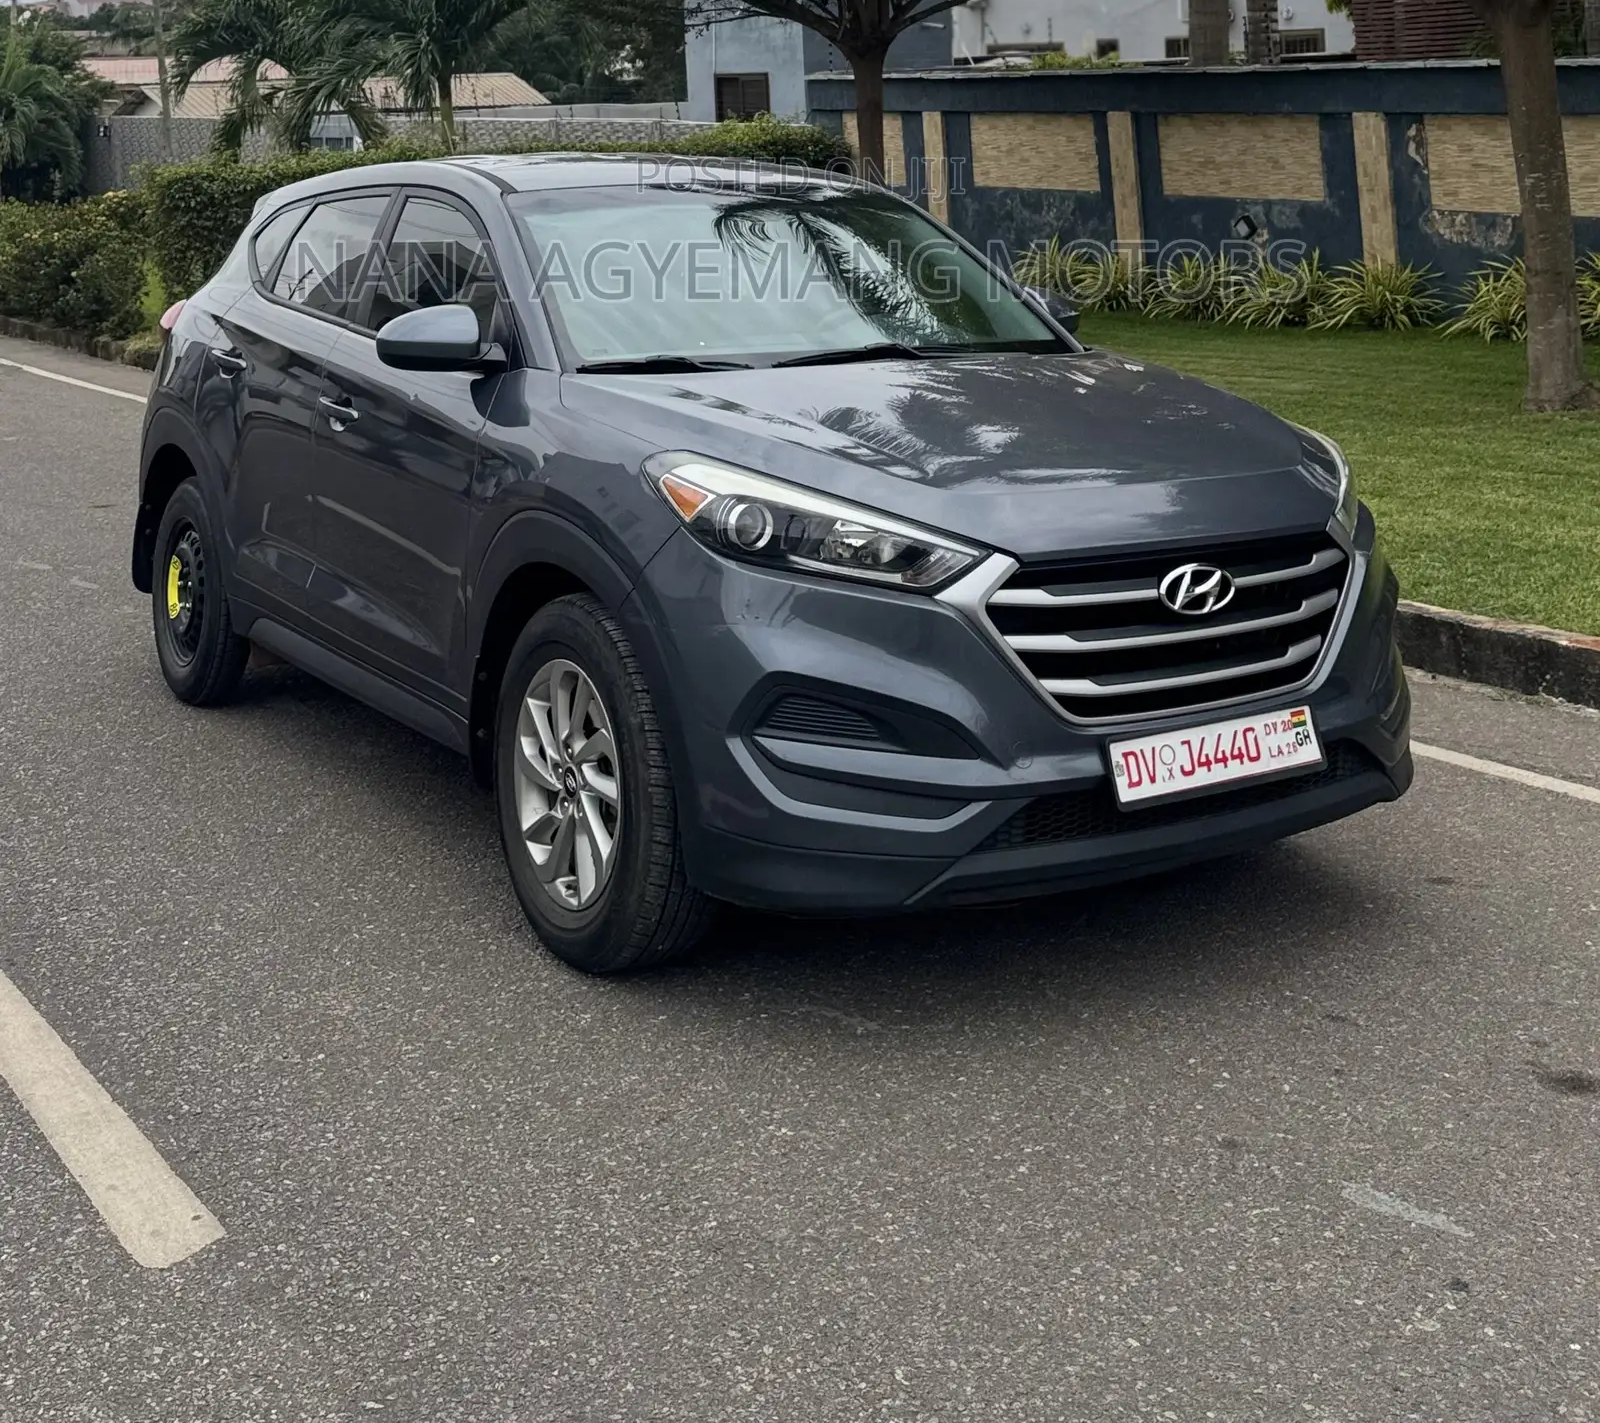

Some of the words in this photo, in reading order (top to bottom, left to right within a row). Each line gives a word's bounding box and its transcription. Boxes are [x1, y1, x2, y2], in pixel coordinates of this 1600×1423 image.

[1263, 721, 1278, 736] DV
[1295, 728, 1312, 747] GH
[1122, 746, 1157, 789] DV
[1180, 727, 1261, 777] J4440
[1268, 744, 1285, 758] LA
